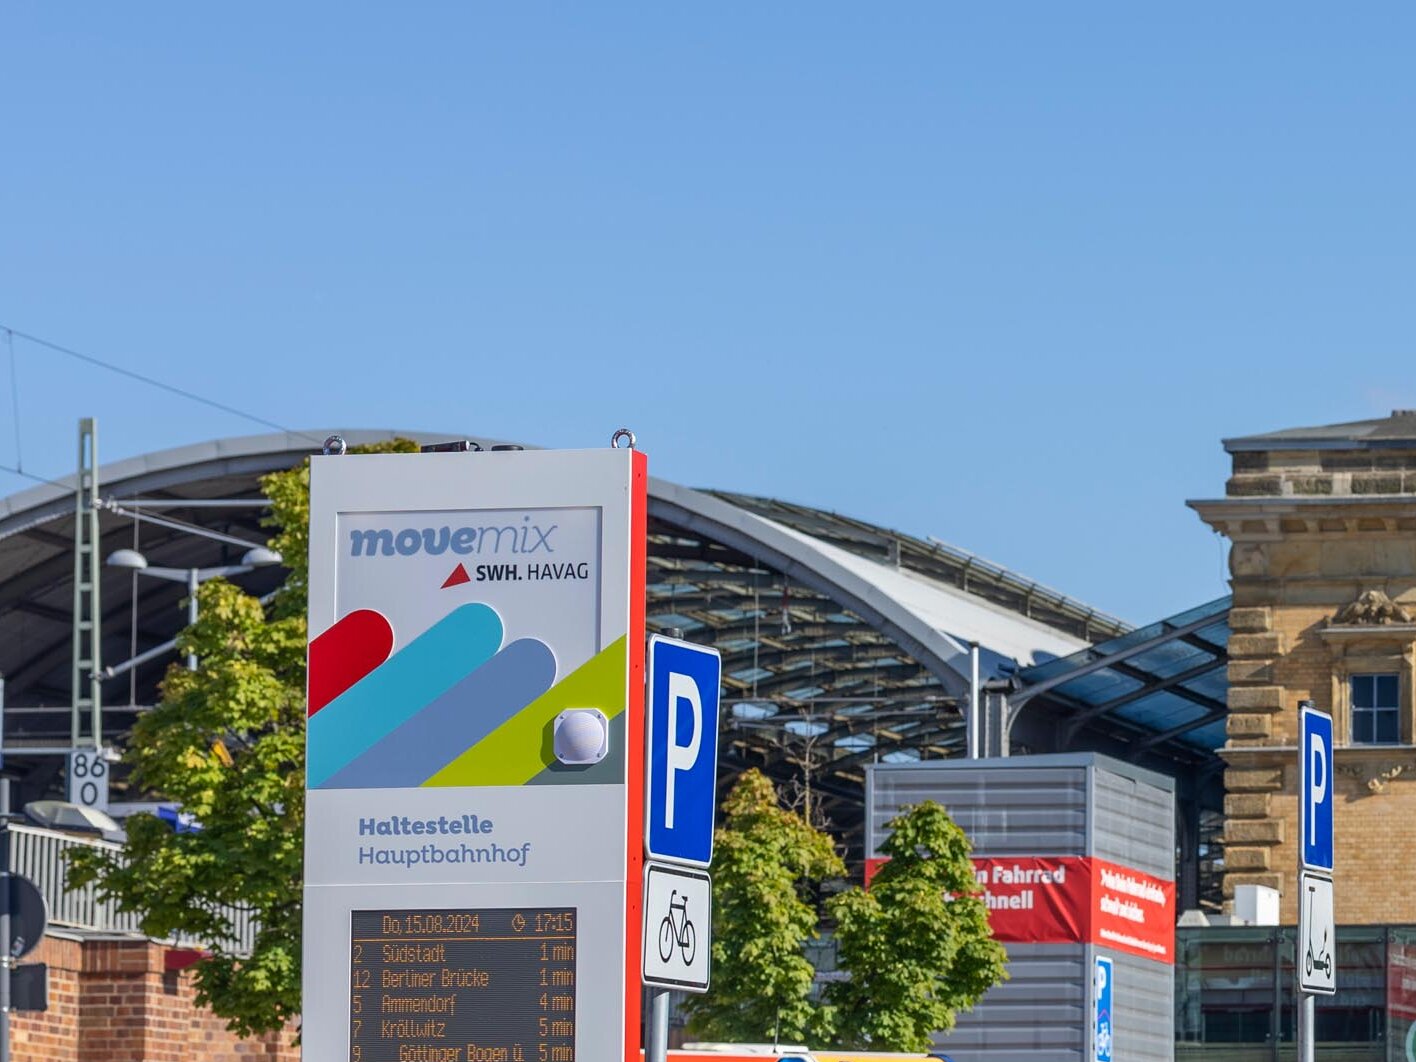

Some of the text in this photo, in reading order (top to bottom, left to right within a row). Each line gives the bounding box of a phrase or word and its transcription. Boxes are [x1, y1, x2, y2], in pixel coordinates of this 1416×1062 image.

[350, 515, 558, 557] movemix
[476, 562, 588, 581] SWH. HAVAG
[665, 672, 702, 829] P
[74, 754, 105, 777] 86
[1311, 733, 1327, 846] P
[359, 815, 493, 835] Haltestelle
[359, 843, 530, 868] Hauptbahnhof
[993, 865, 1065, 884] Fahrrad
[535, 913, 573, 932] 17:15
[353, 942, 574, 963] 2 Südstadt 1 min
[353, 968, 574, 988] 12 Berliner Brücke 1 min
[353, 992, 573, 1015] 5 Ammendorf 4 min
[353, 1018, 573, 1038] 7 Kröllwitz 5 min
[539, 1043, 549, 1061] 5
[552, 1043, 573, 1060] min
